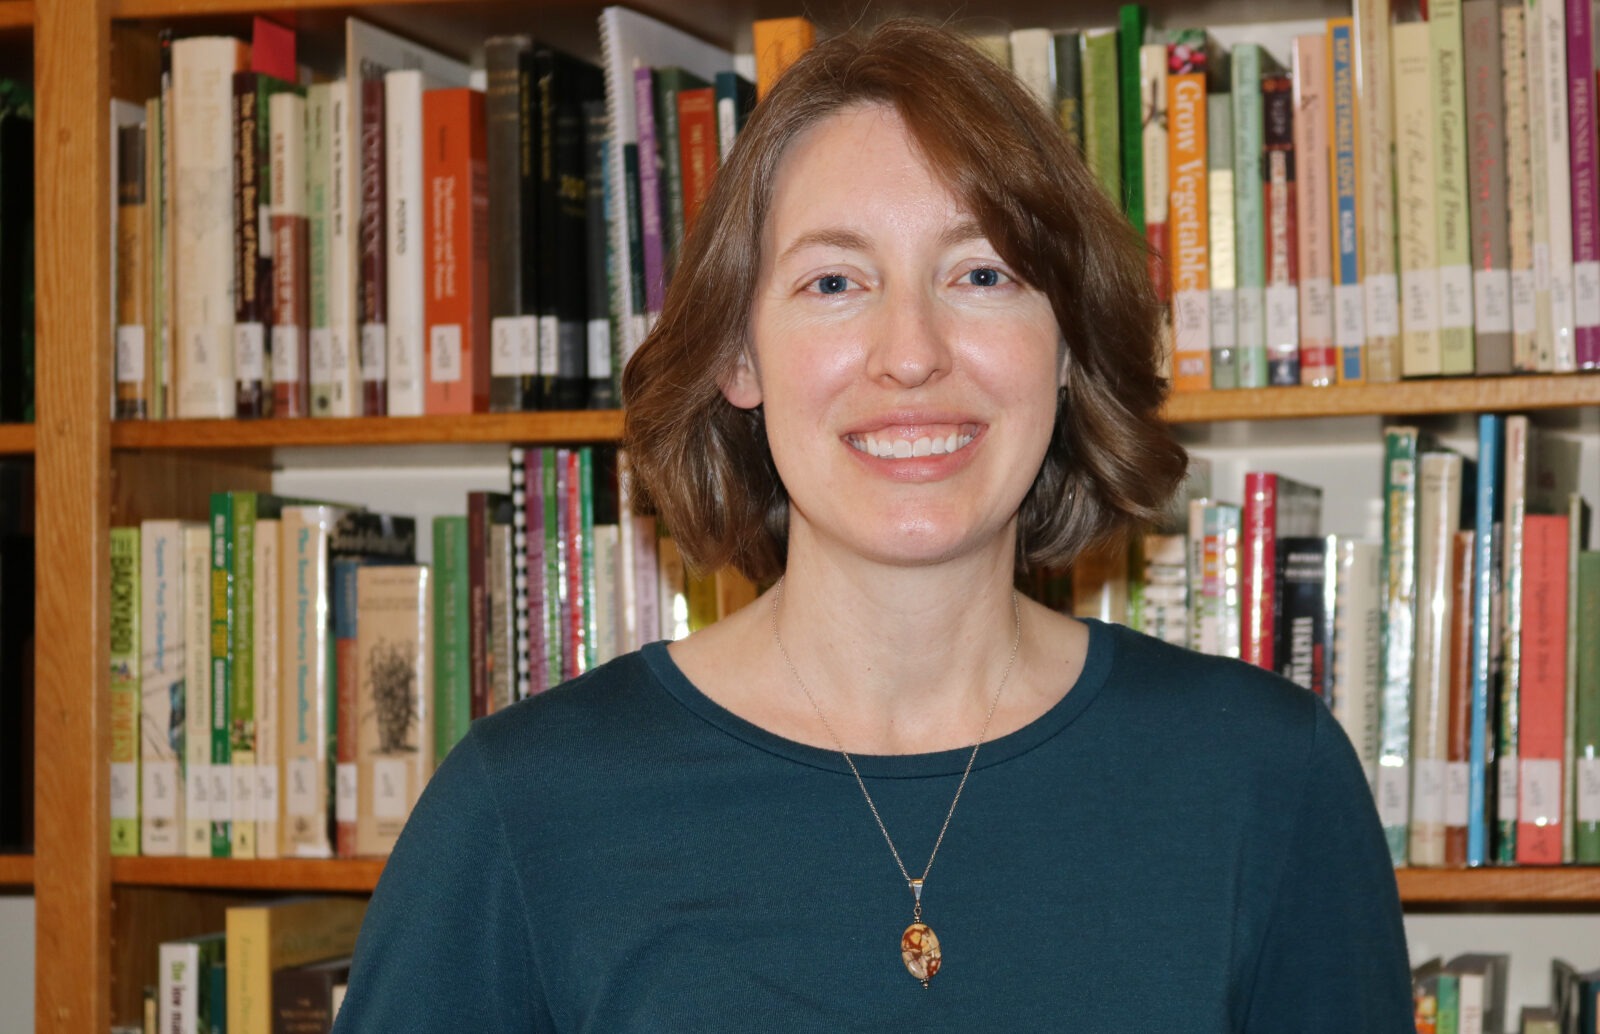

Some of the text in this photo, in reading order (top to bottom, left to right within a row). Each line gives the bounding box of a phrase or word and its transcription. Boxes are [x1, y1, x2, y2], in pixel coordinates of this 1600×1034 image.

[1437, 50, 1457, 106] Kitchen
[1174, 81, 1202, 155] Grow
[1335, 38, 1355, 254] MY VEGETABLE LOVE KLAUS
[1440, 110, 1459, 177] Gardens
[1573, 78, 1591, 162] PERENNIAL
[239, 93, 257, 302] The Complete Book of Potatoes
[396, 198, 407, 257] POTATO
[1444, 200, 1461, 252] France
[154, 538, 167, 577] Square
[237, 525, 252, 577] Kitchen
[110, 556, 134, 655] BACKYARD
[195, 612, 205, 645] FOOT
[212, 514, 228, 730] ALL NEW SQUARE FOOT GARDENING
[194, 649, 205, 727] GARDENING
